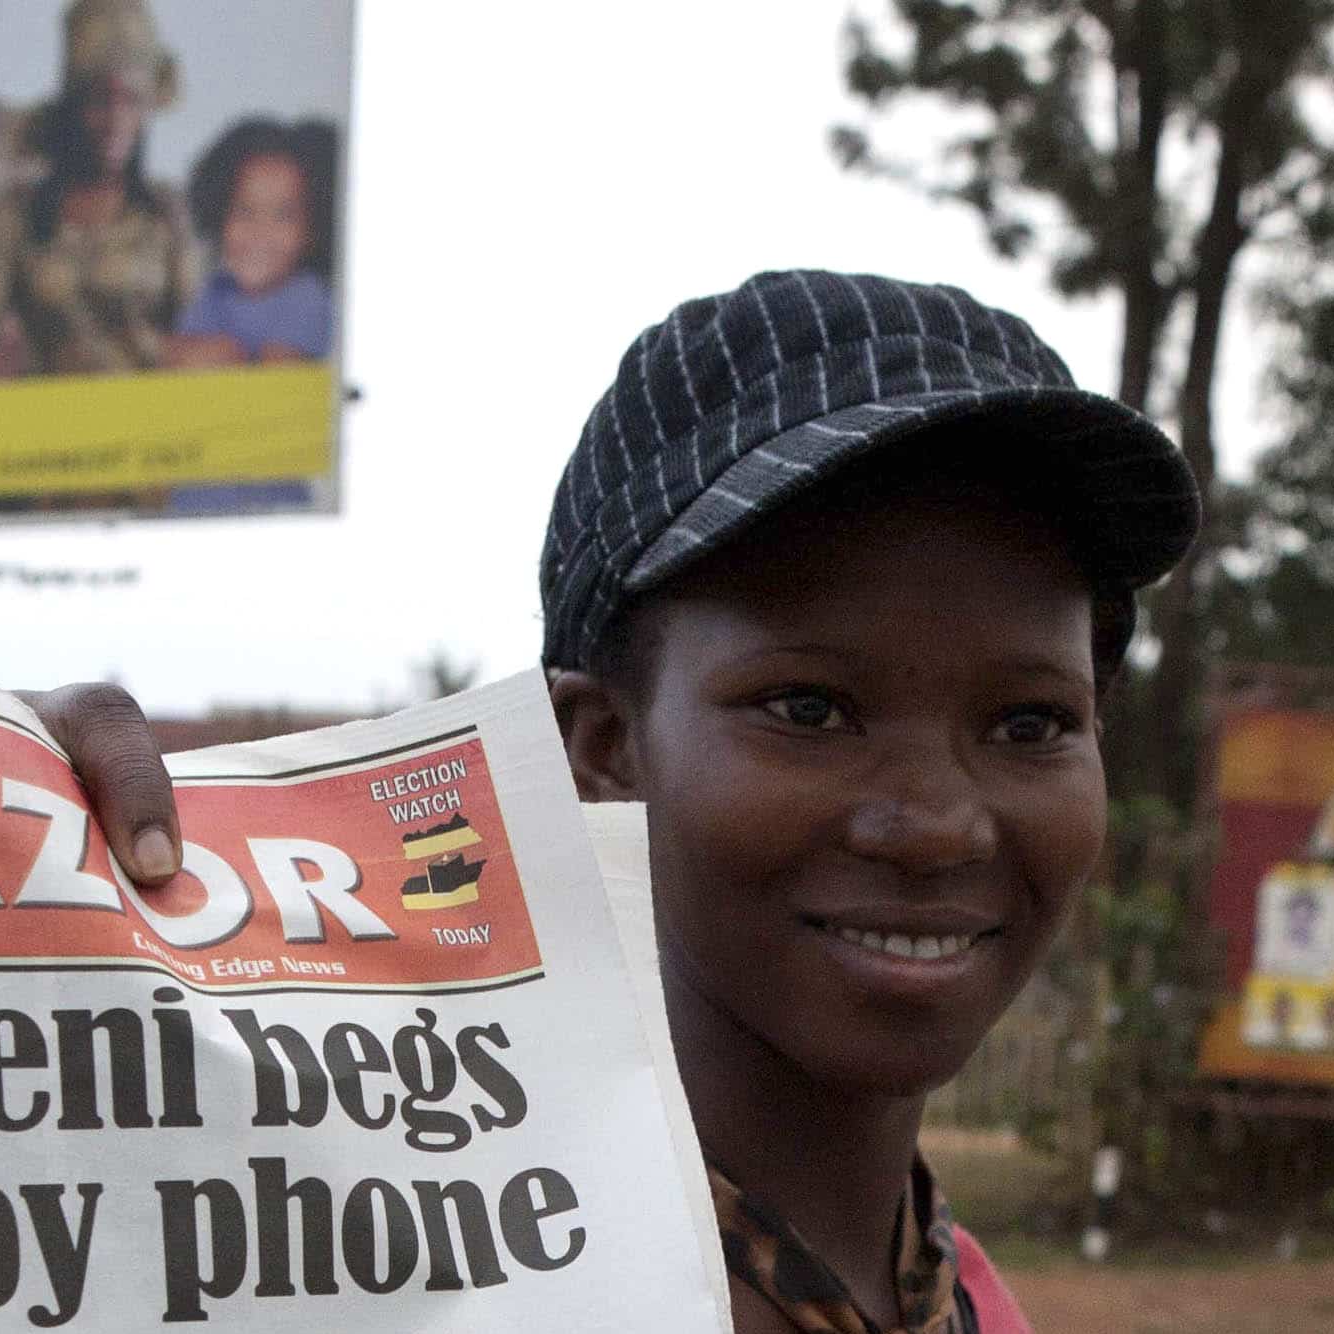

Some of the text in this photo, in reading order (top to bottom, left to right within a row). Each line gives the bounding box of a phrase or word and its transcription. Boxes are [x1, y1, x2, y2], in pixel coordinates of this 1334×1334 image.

[369, 758, 467, 803] ELECTION
[387, 789, 462, 826] WATCH
[432, 922, 493, 947] TODAY
[210, 955, 275, 979] Edge
[279, 955, 346, 976] News
[220, 1006, 529, 1153] begs
[154, 1156, 587, 1323] phone
